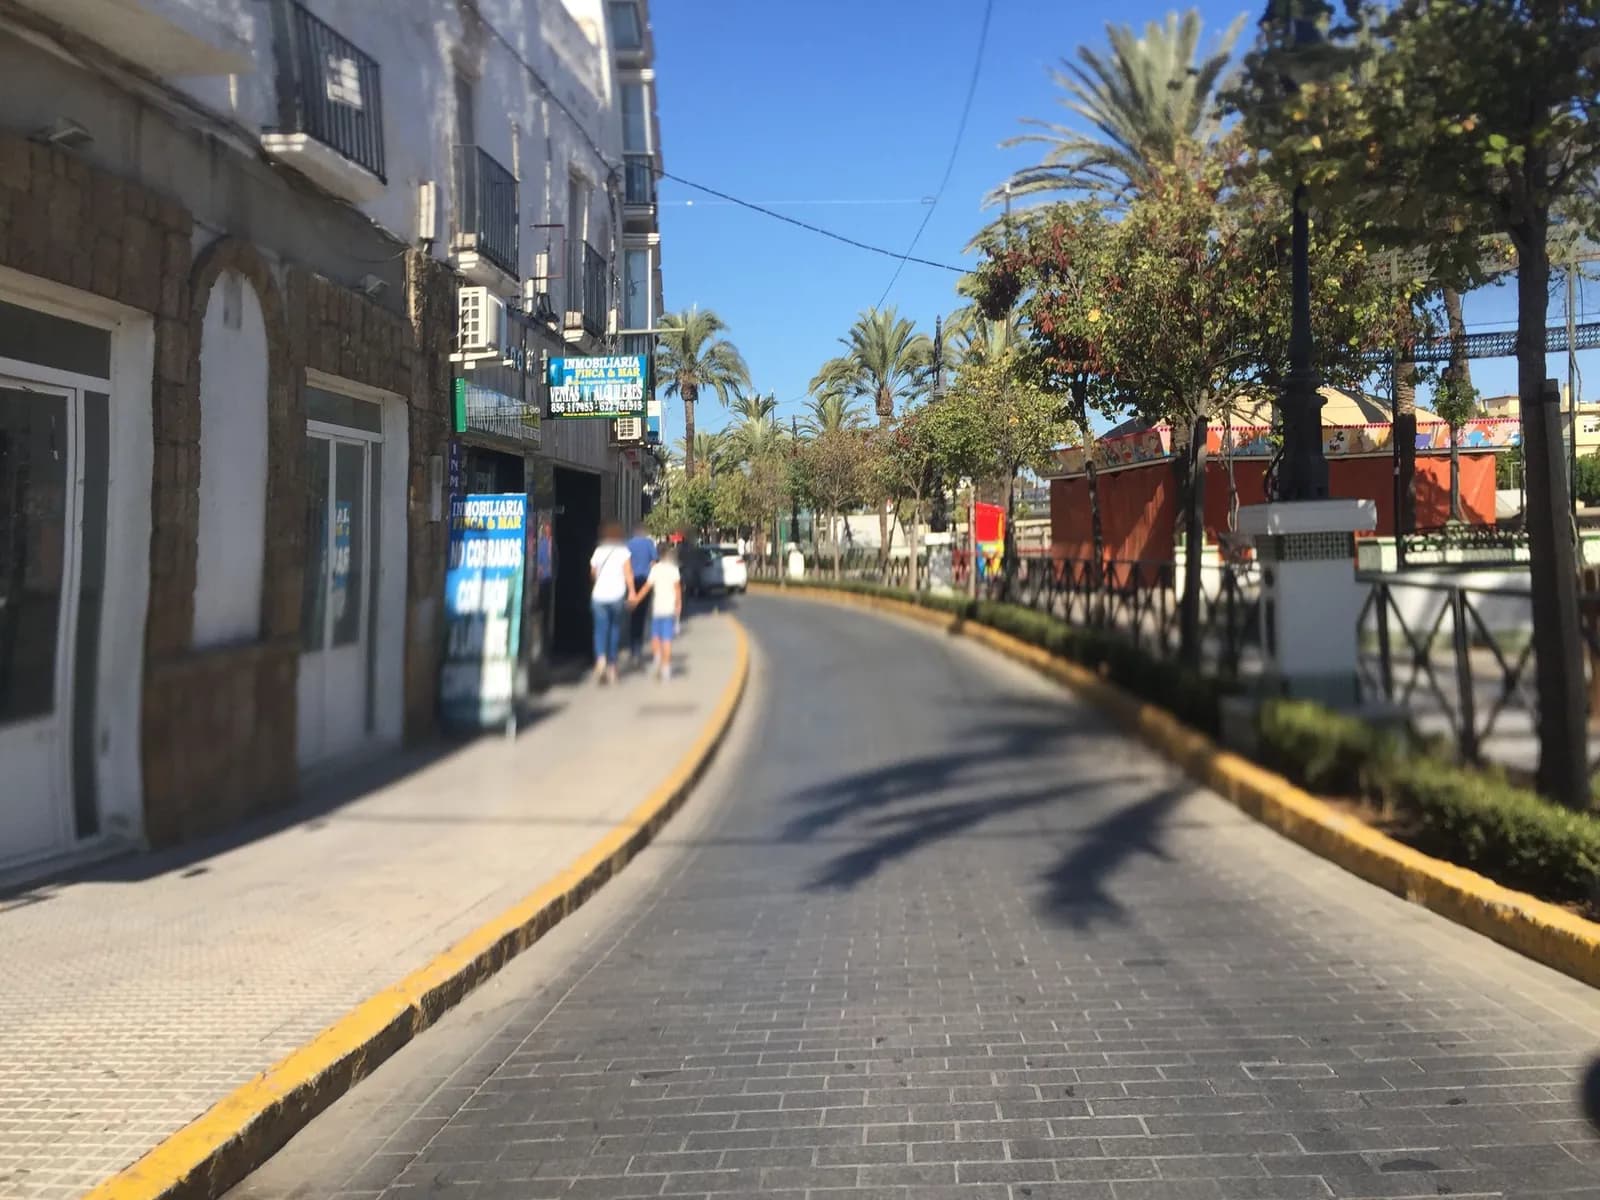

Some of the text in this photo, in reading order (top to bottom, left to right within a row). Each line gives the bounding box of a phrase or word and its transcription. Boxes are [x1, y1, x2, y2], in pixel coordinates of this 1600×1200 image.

[564, 357, 639, 369] INMOBILIARIA
[550, 386, 579, 402] VENTAS
[551, 402, 565, 413] 856
[452, 500, 524, 517] INMOBILIARIA
[498, 516, 521, 529] MAR
